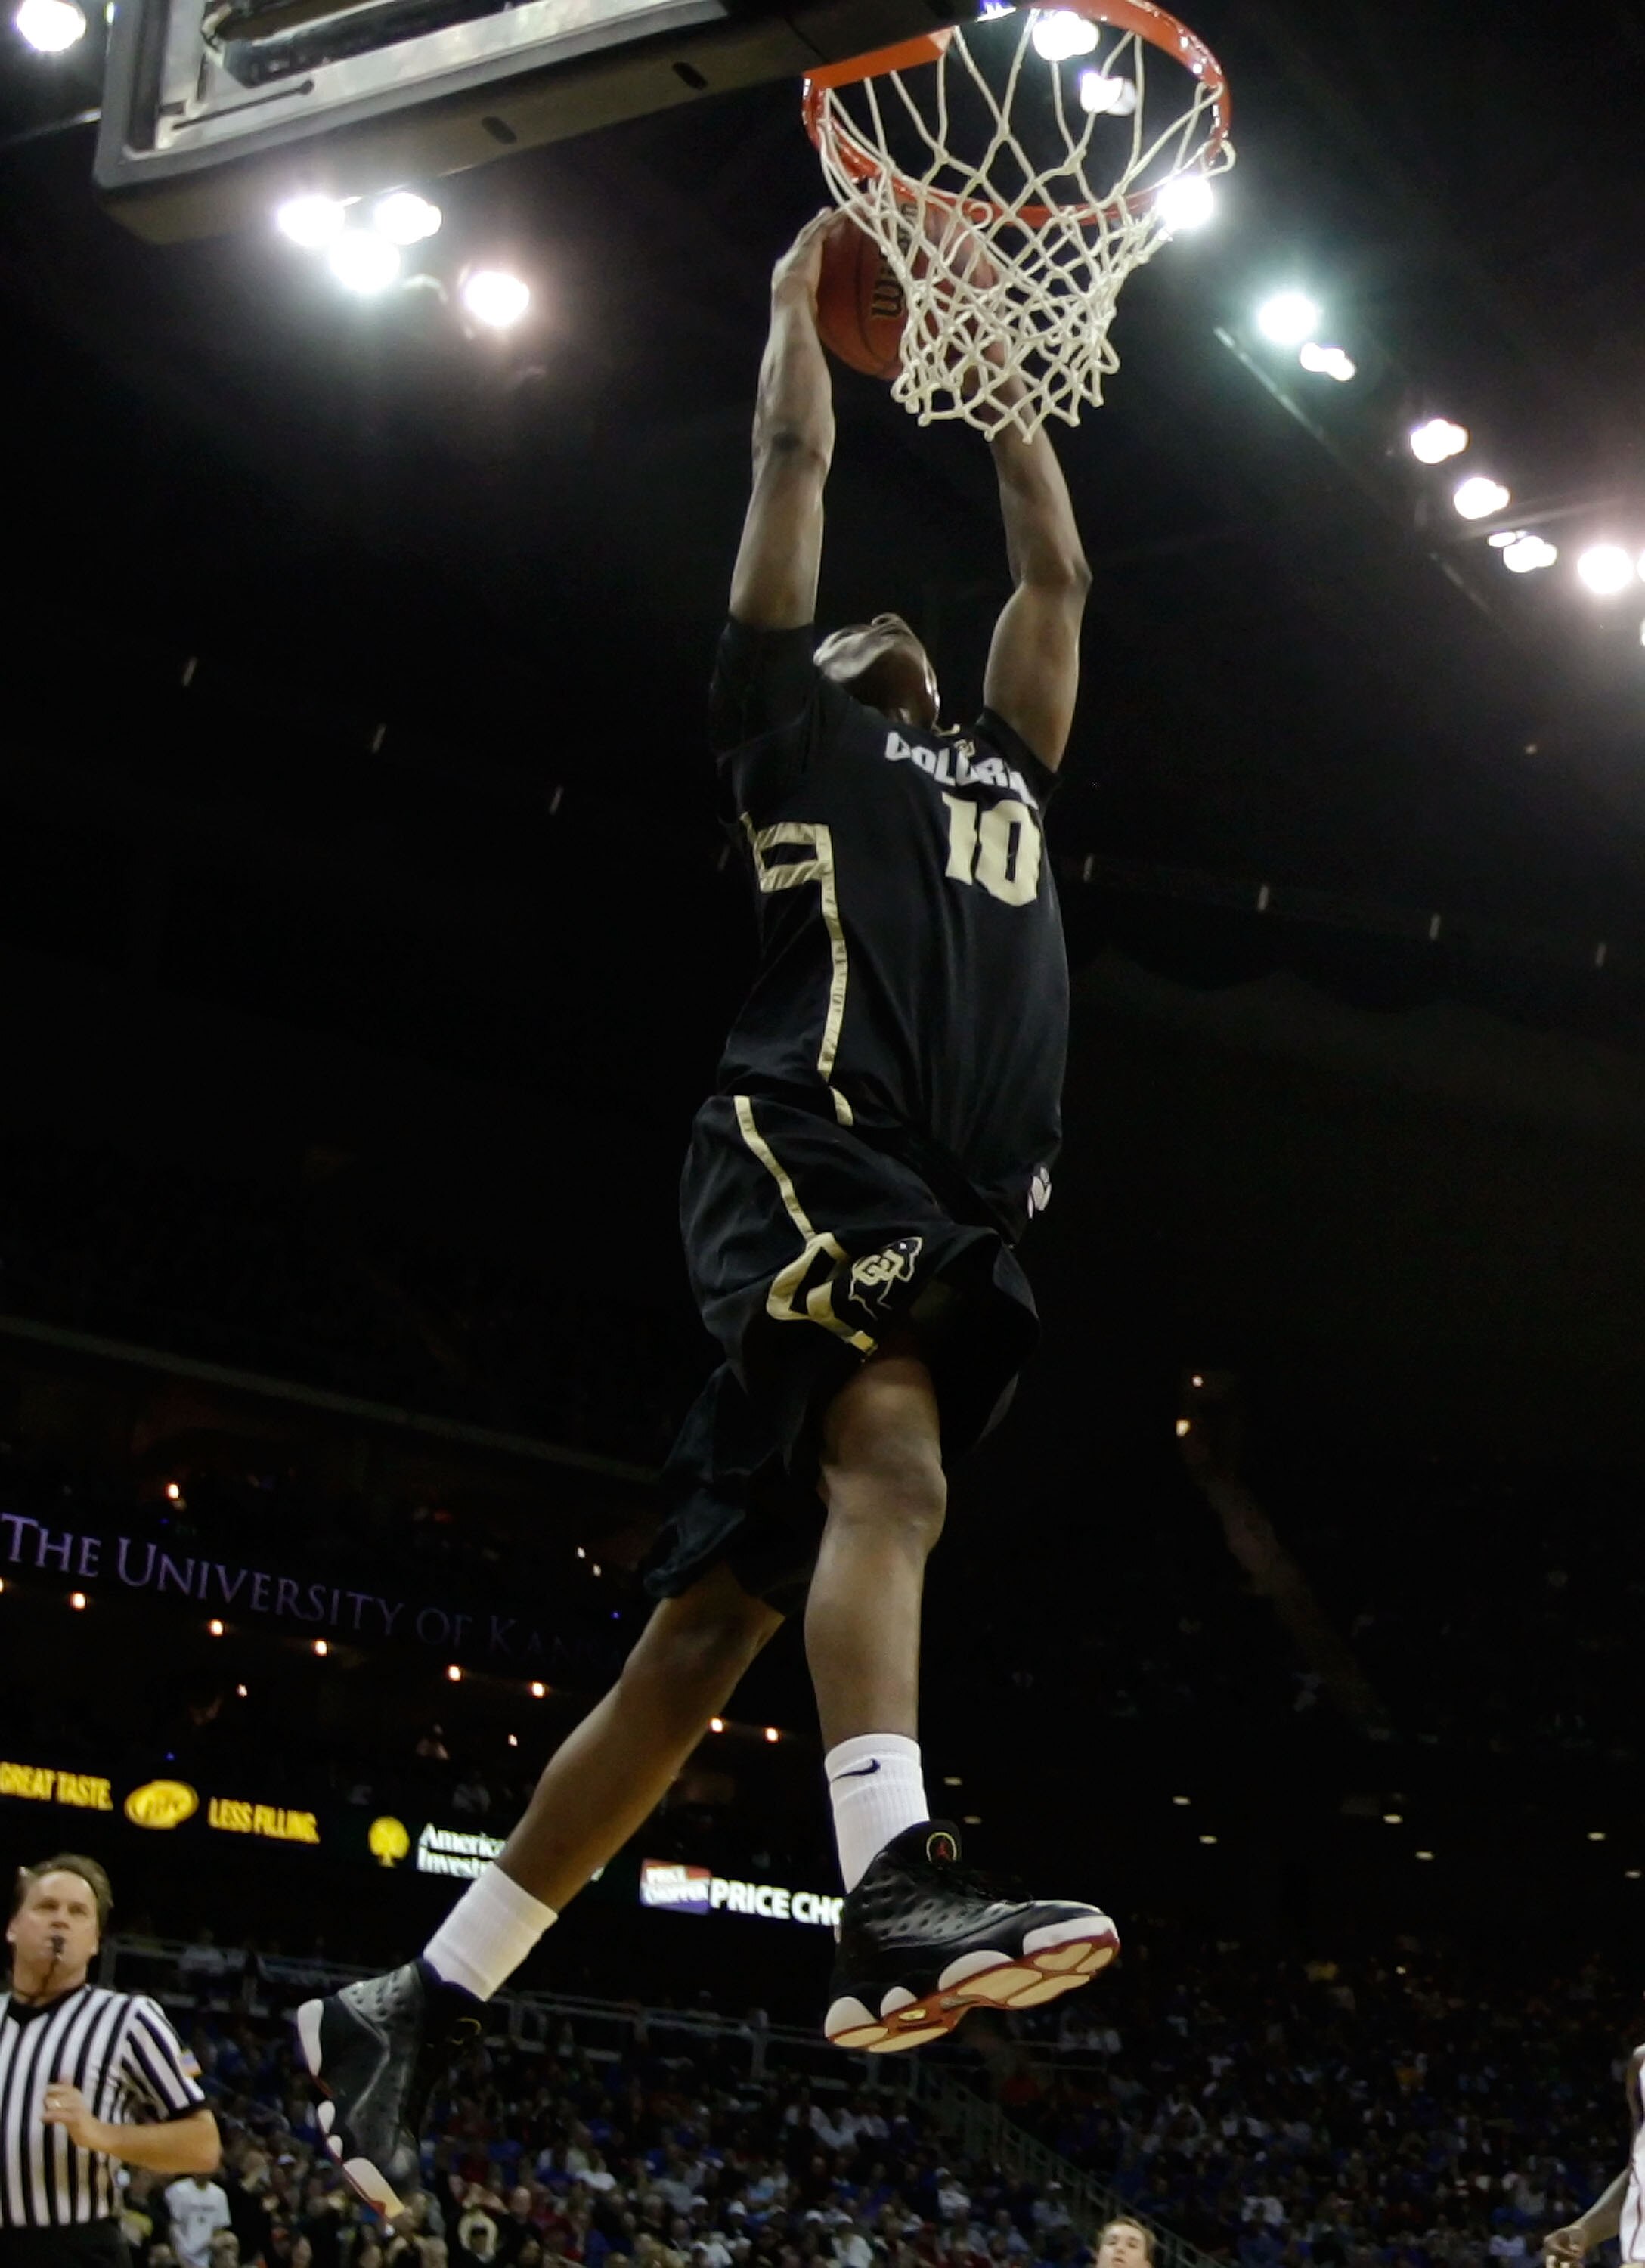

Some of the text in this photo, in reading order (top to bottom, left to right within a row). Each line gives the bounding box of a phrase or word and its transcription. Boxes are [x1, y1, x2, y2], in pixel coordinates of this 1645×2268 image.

[942, 791, 1041, 906] 10
[0, 1512, 102, 1578] THE
[116, 1535, 404, 1636] UNIVERSITY
[416, 1606, 472, 1649] OF
[711, 1876, 791, 1919] PRICE
